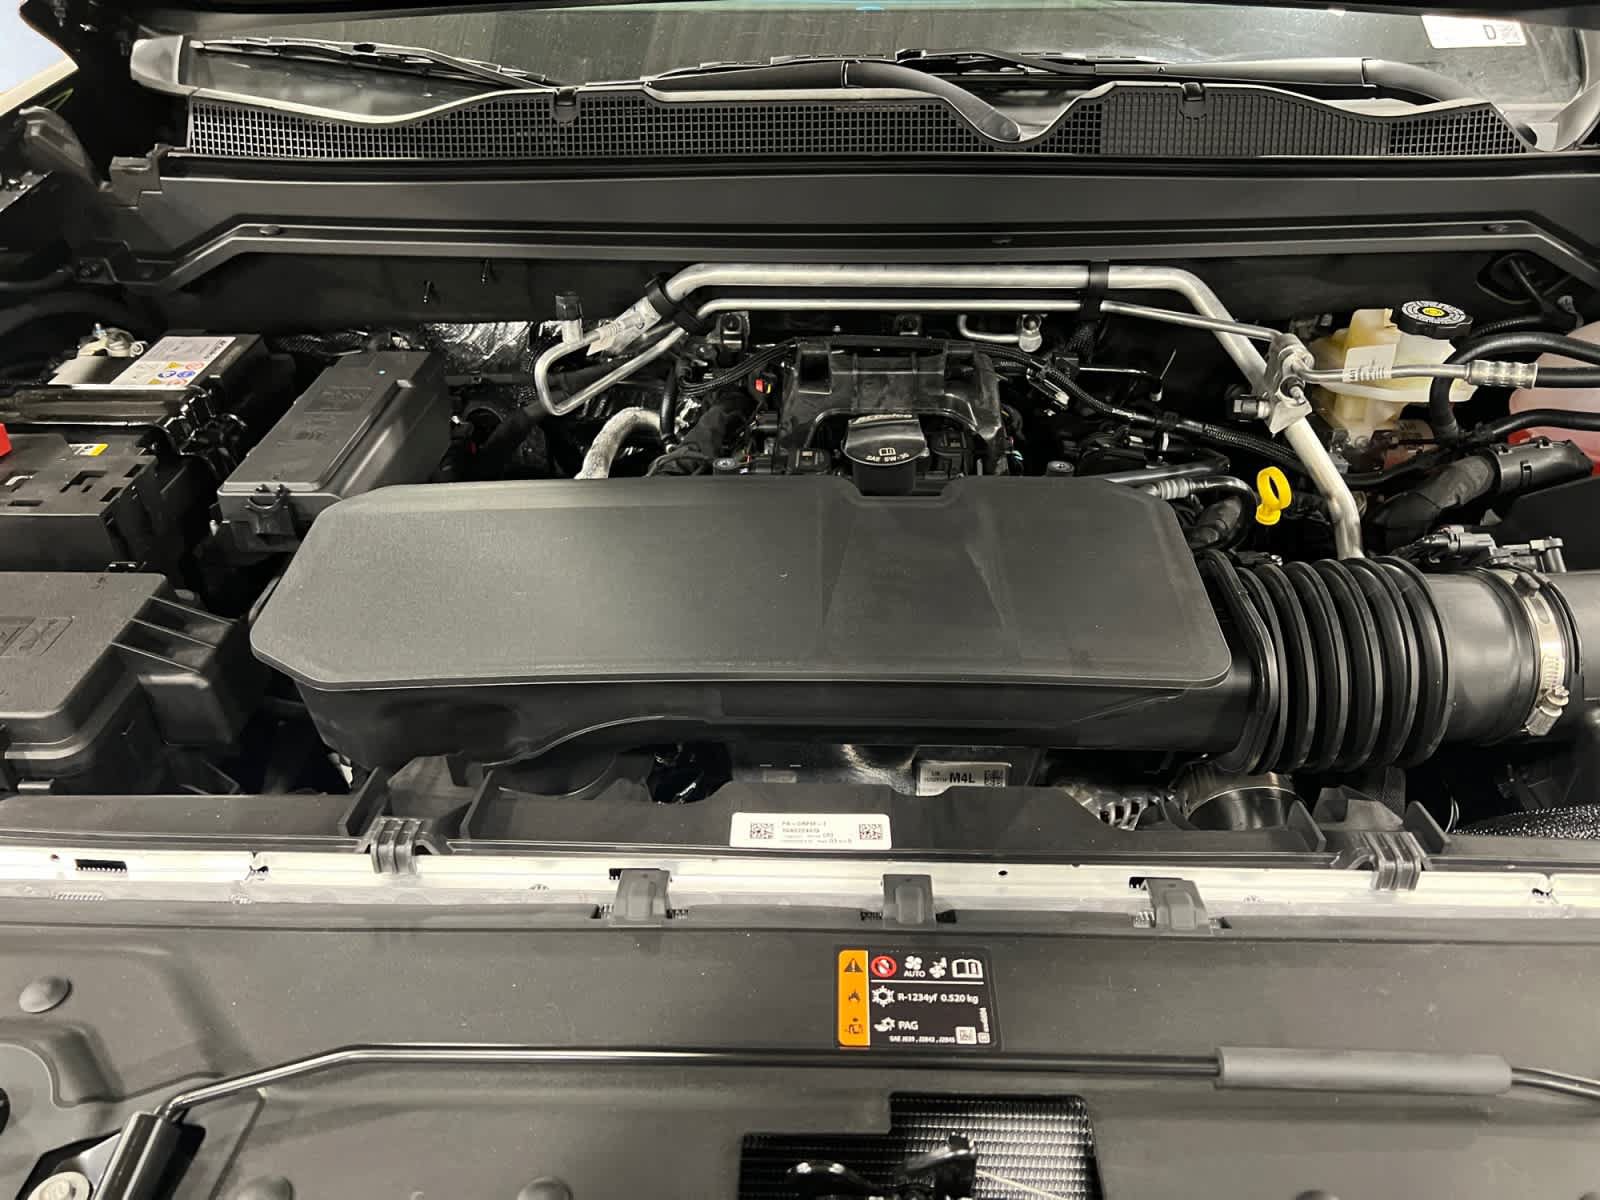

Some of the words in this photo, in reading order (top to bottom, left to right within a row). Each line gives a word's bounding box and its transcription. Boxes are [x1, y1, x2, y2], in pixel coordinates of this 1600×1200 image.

[949, 772, 976, 784] M4L
[898, 993, 938, 1003] R-1234yf
[940, 994, 966, 1002] 0.520
[966, 993, 979, 1004] kg
[898, 1020, 919, 1031] PAG
